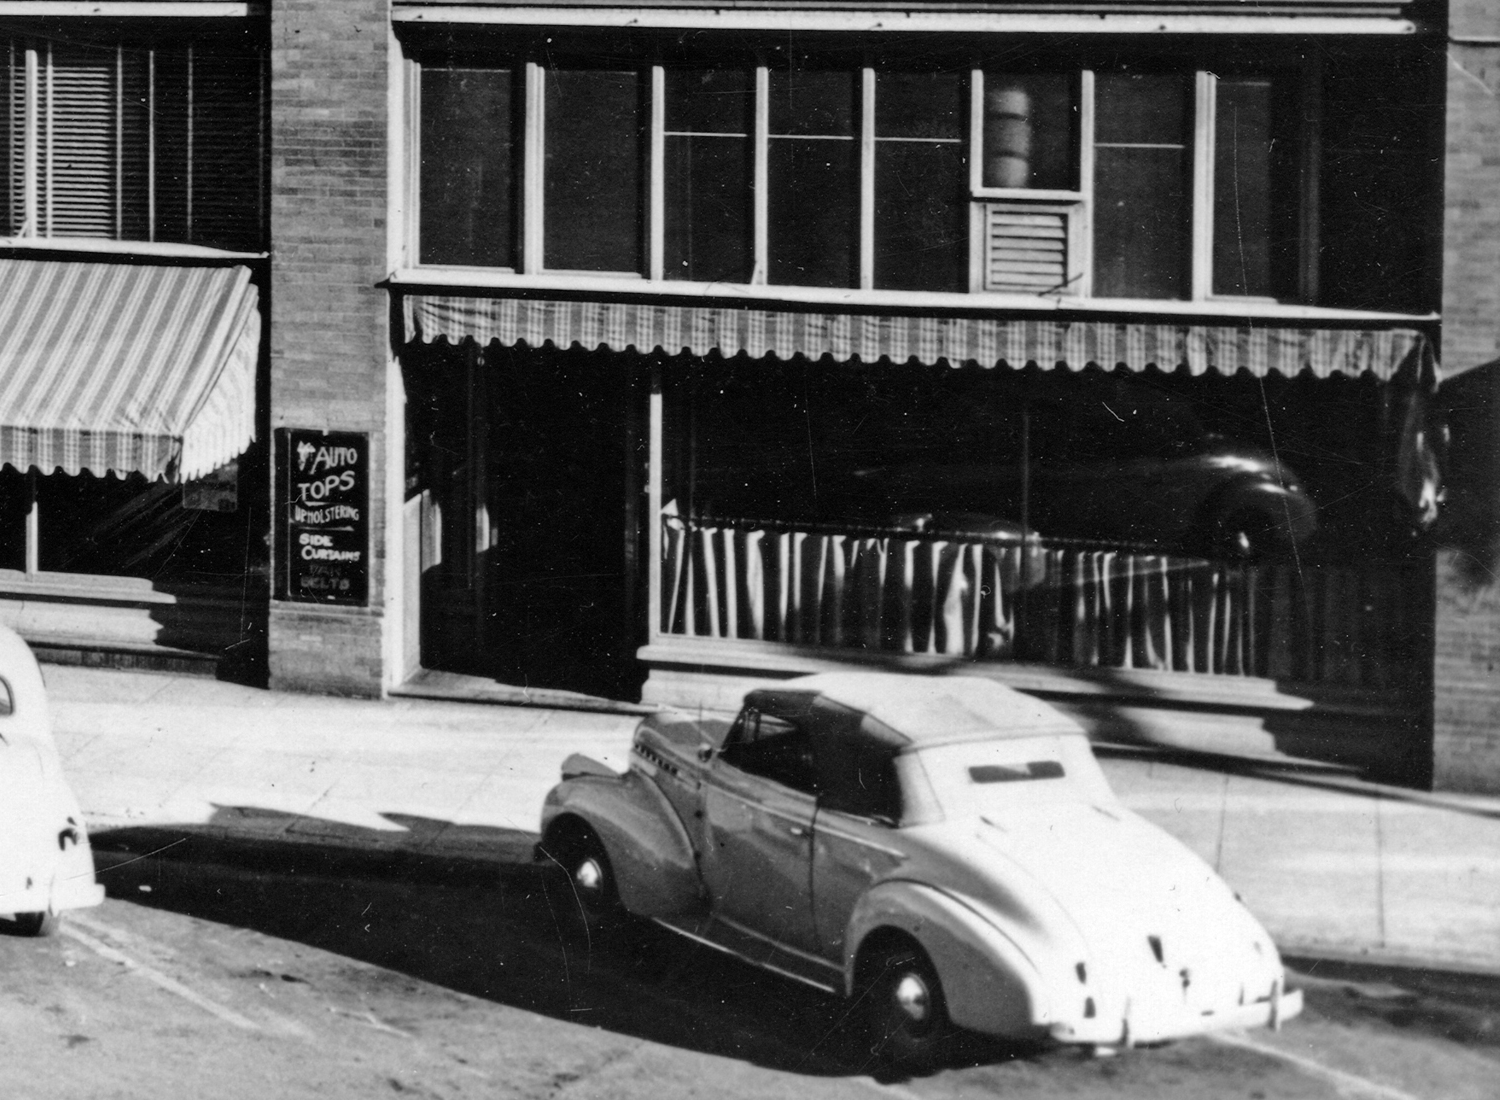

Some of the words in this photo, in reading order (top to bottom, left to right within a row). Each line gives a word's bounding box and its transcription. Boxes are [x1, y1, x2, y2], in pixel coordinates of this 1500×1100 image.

[309, 446, 358, 475] AUTO
[297, 470, 356, 501] TOPS
[294, 504, 360, 525] UPHOLSTERING
[299, 533, 334, 547] SIDE
[301, 545, 361, 562] CURTAINS
